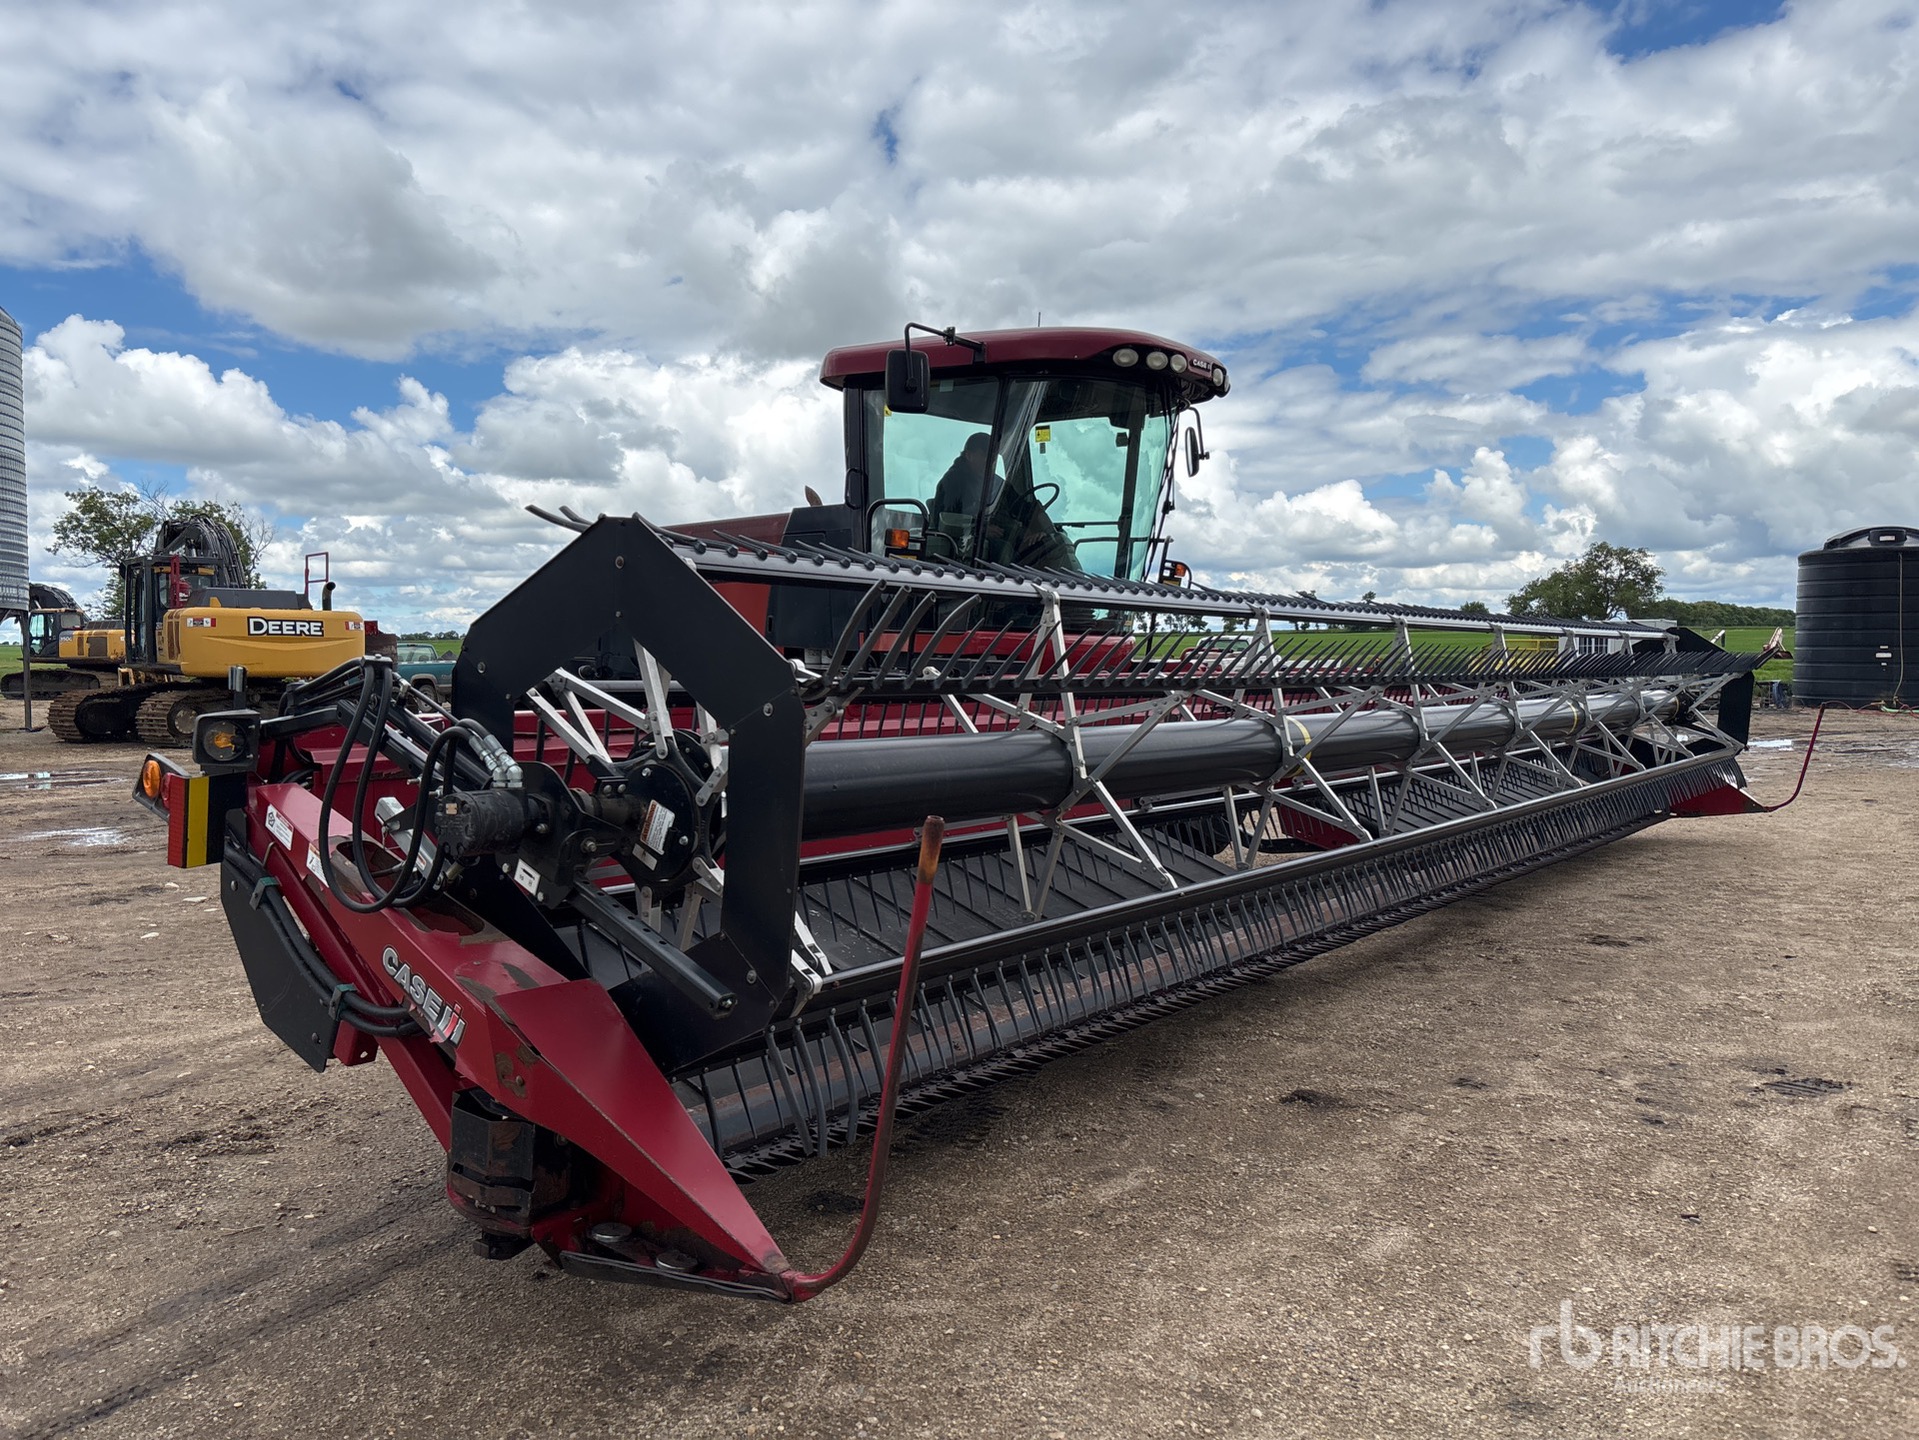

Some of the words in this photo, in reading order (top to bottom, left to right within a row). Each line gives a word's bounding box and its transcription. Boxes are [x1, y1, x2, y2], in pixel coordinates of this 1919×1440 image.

[1193, 359, 1207, 369] CASE
[249, 618, 322, 635] DEERE
[382, 947, 443, 1021] CASE
